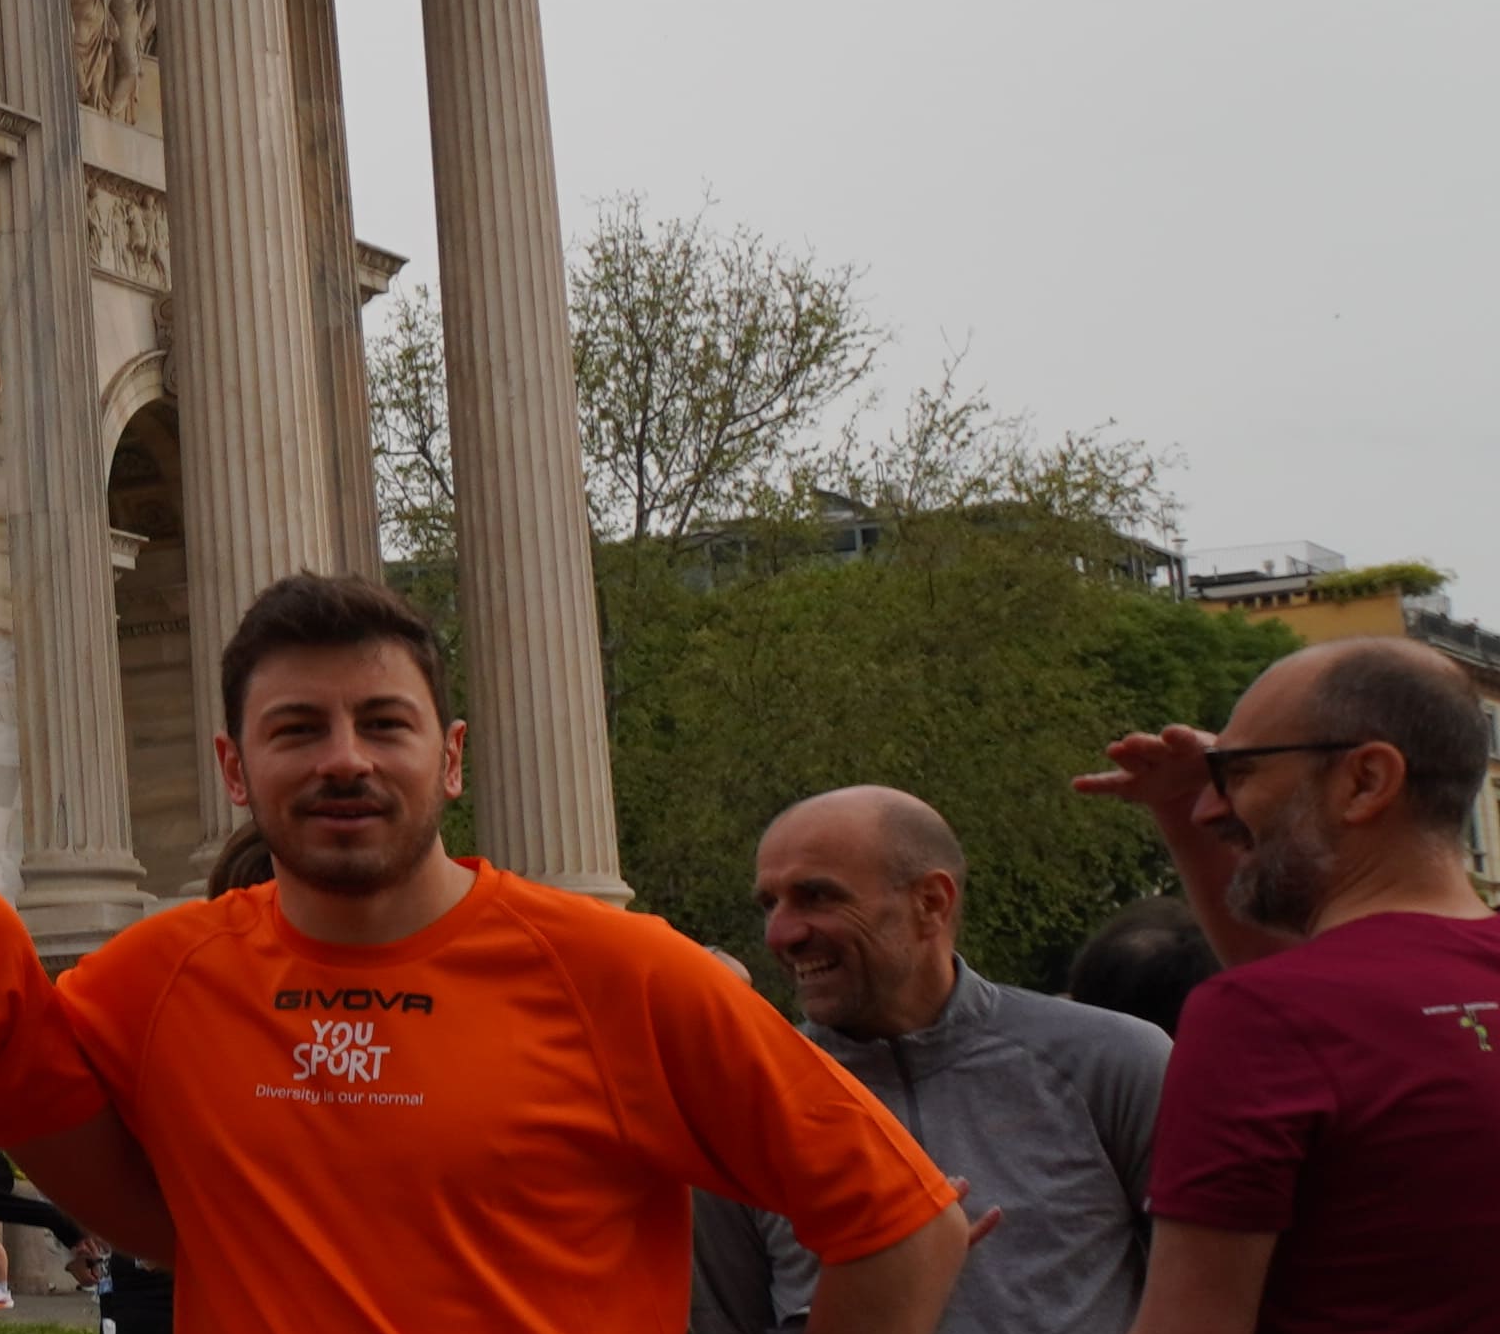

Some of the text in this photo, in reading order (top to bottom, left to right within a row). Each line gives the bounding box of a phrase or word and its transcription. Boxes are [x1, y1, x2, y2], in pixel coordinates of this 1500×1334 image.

[274, 989, 433, 1015] GIVOVA
[312, 1019, 374, 1055] YOU
[293, 1043, 391, 1083] SPORT
[255, 1083, 423, 1106] Diversity is our normal
